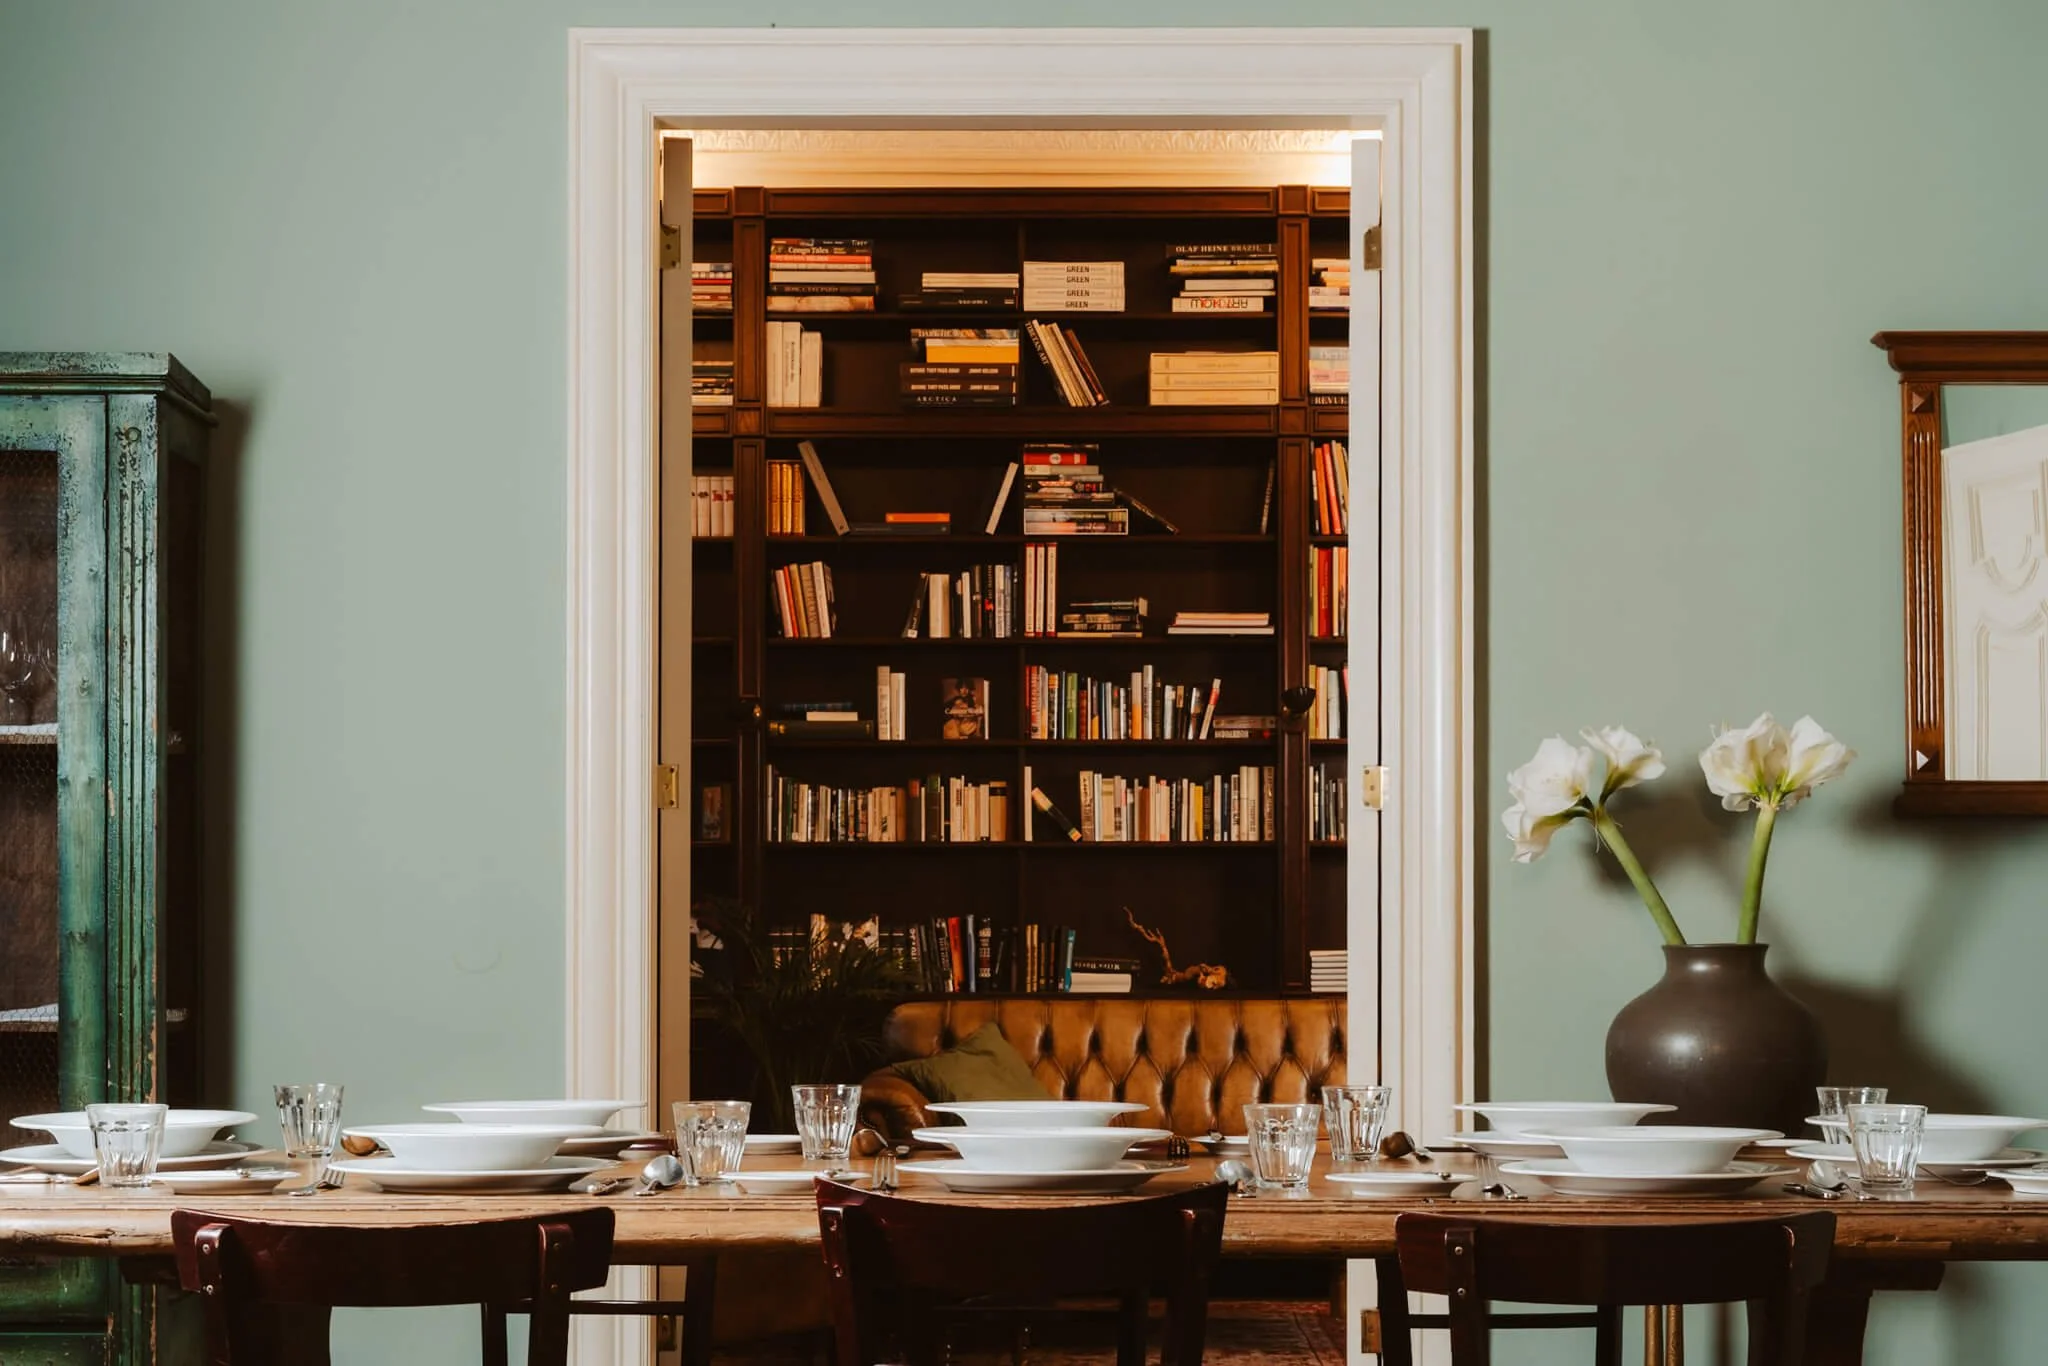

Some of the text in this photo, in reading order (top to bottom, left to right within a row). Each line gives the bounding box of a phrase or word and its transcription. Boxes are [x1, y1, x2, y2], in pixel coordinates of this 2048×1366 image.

[811, 246, 829, 254] Tales
[1176, 245, 1198, 253] OLAF
[1231, 244, 1261, 252] BRAZIL
[1066, 265, 1090, 273] GREEN
[1066, 289, 1090, 297] GREEN
[1064, 300, 1089, 308] GREEN
[1039, 351, 1050, 366] ART
